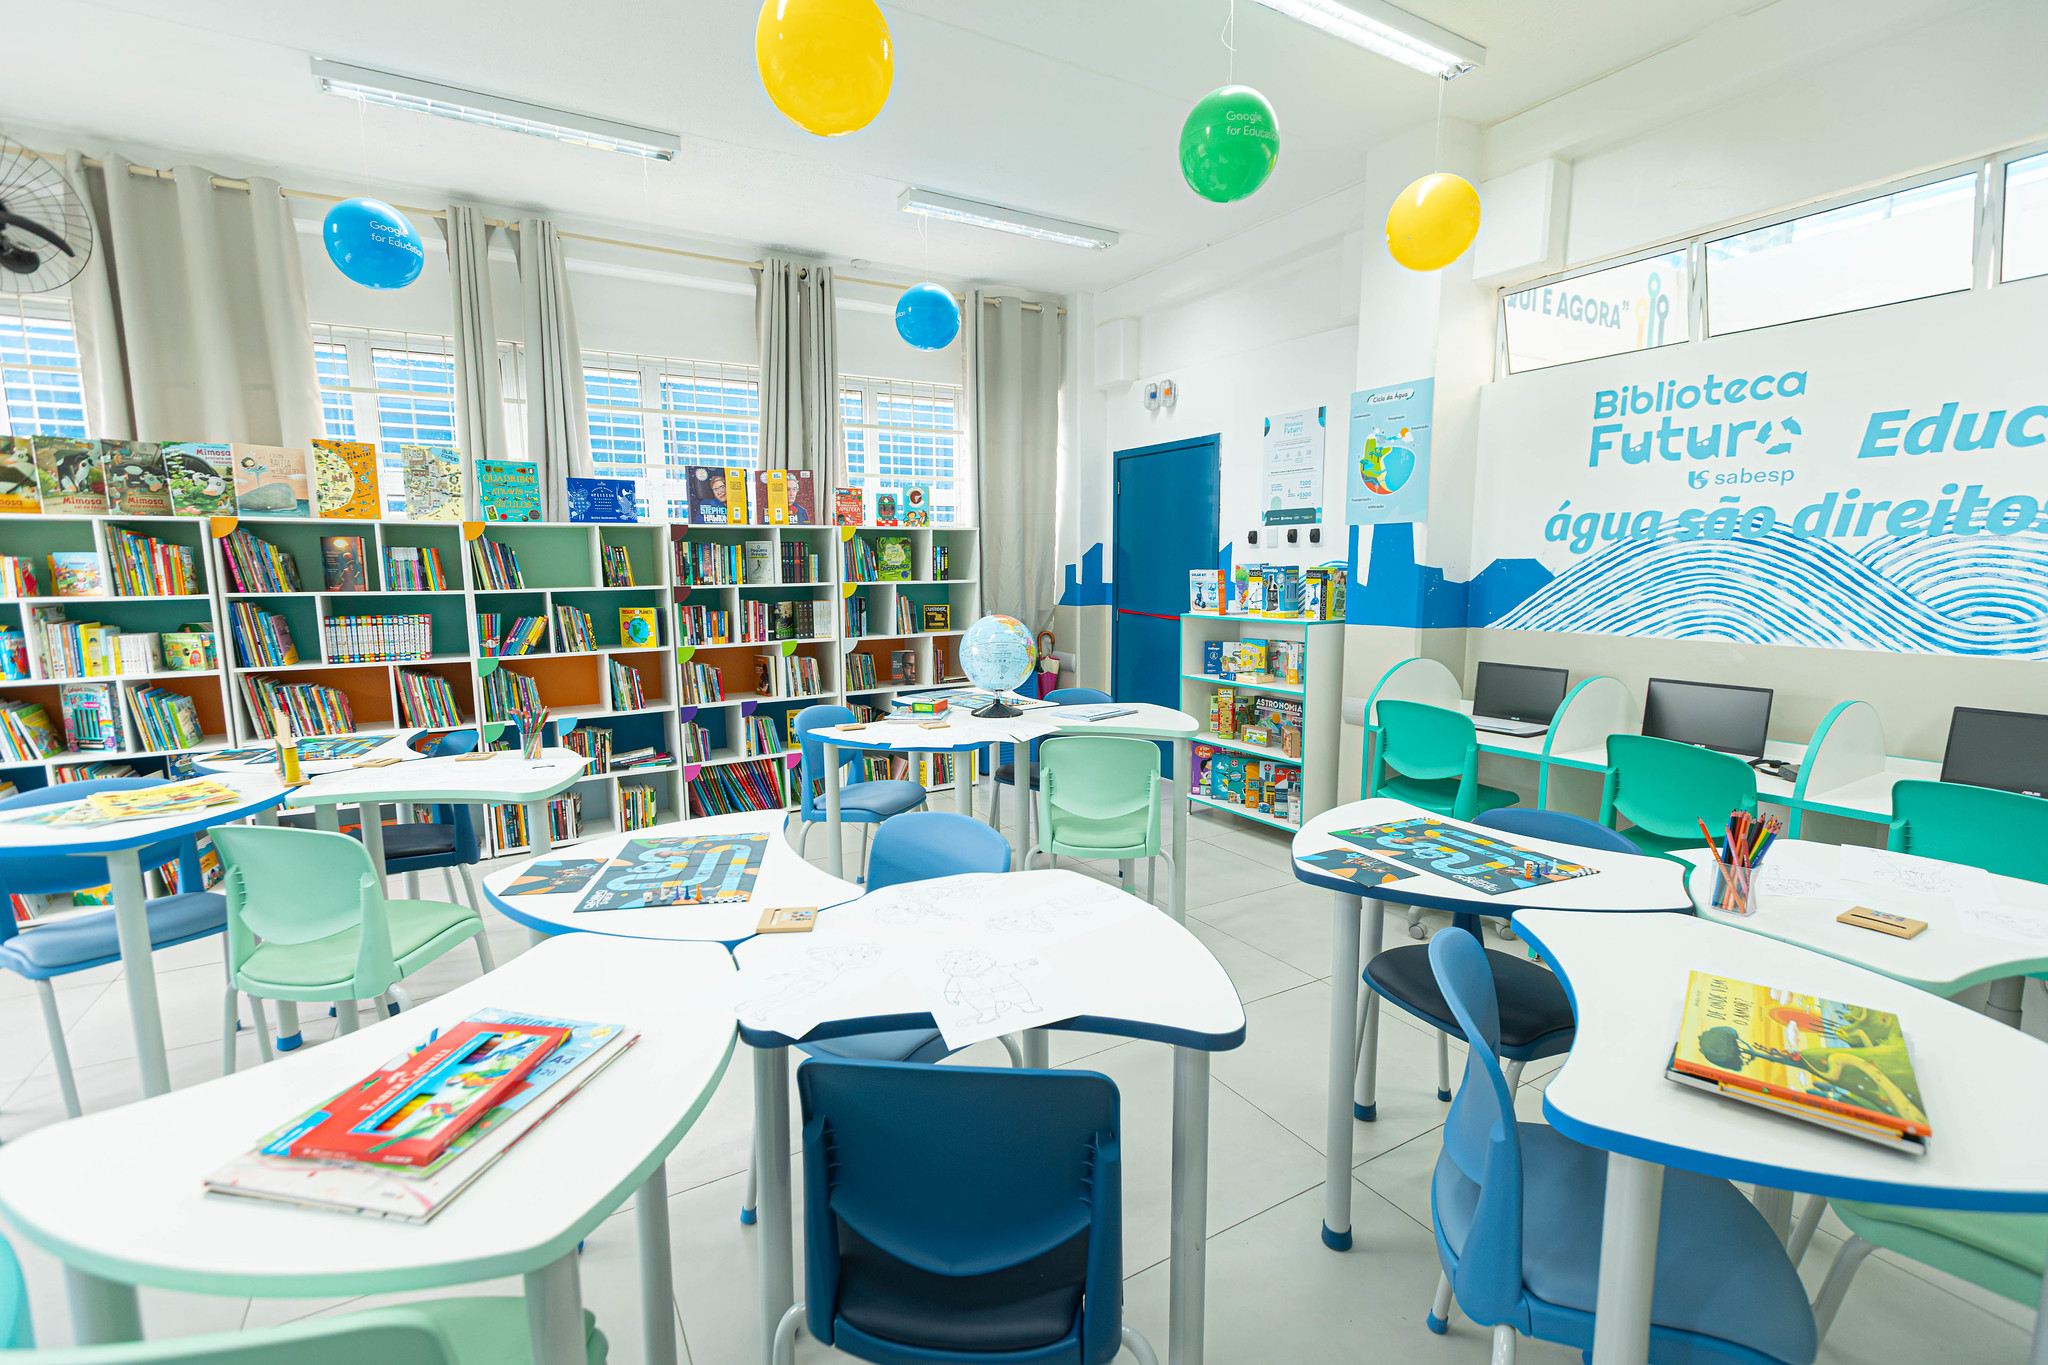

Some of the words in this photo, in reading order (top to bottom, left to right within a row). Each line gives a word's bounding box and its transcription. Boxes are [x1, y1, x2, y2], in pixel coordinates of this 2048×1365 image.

[1226, 110, 1262, 124] Google
[1226, 125, 1241, 136] for
[369, 220, 408, 238] Google
[371, 232, 386, 243] for
[1542, 288, 1553, 315] E
[1394, 391, 1409, 400] Água
[1593, 369, 1808, 420] Biblioteca
[196, 448, 231, 457] Mimosa
[482, 474, 538, 484] QUADRIBOL
[1713, 466, 1796, 487] sabesp
[491, 487, 524, 496] ATRAVÉS
[62, 496, 102, 506] Mimosa
[127, 496, 164, 505] Mimosa
[1544, 500, 1663, 555] água
[1677, 495, 1777, 541] são
[1256, 699, 1303, 713] ASTRONOMIA
[1709, 978, 1729, 993] VEM
[1706, 1009, 1727, 1021] DE
